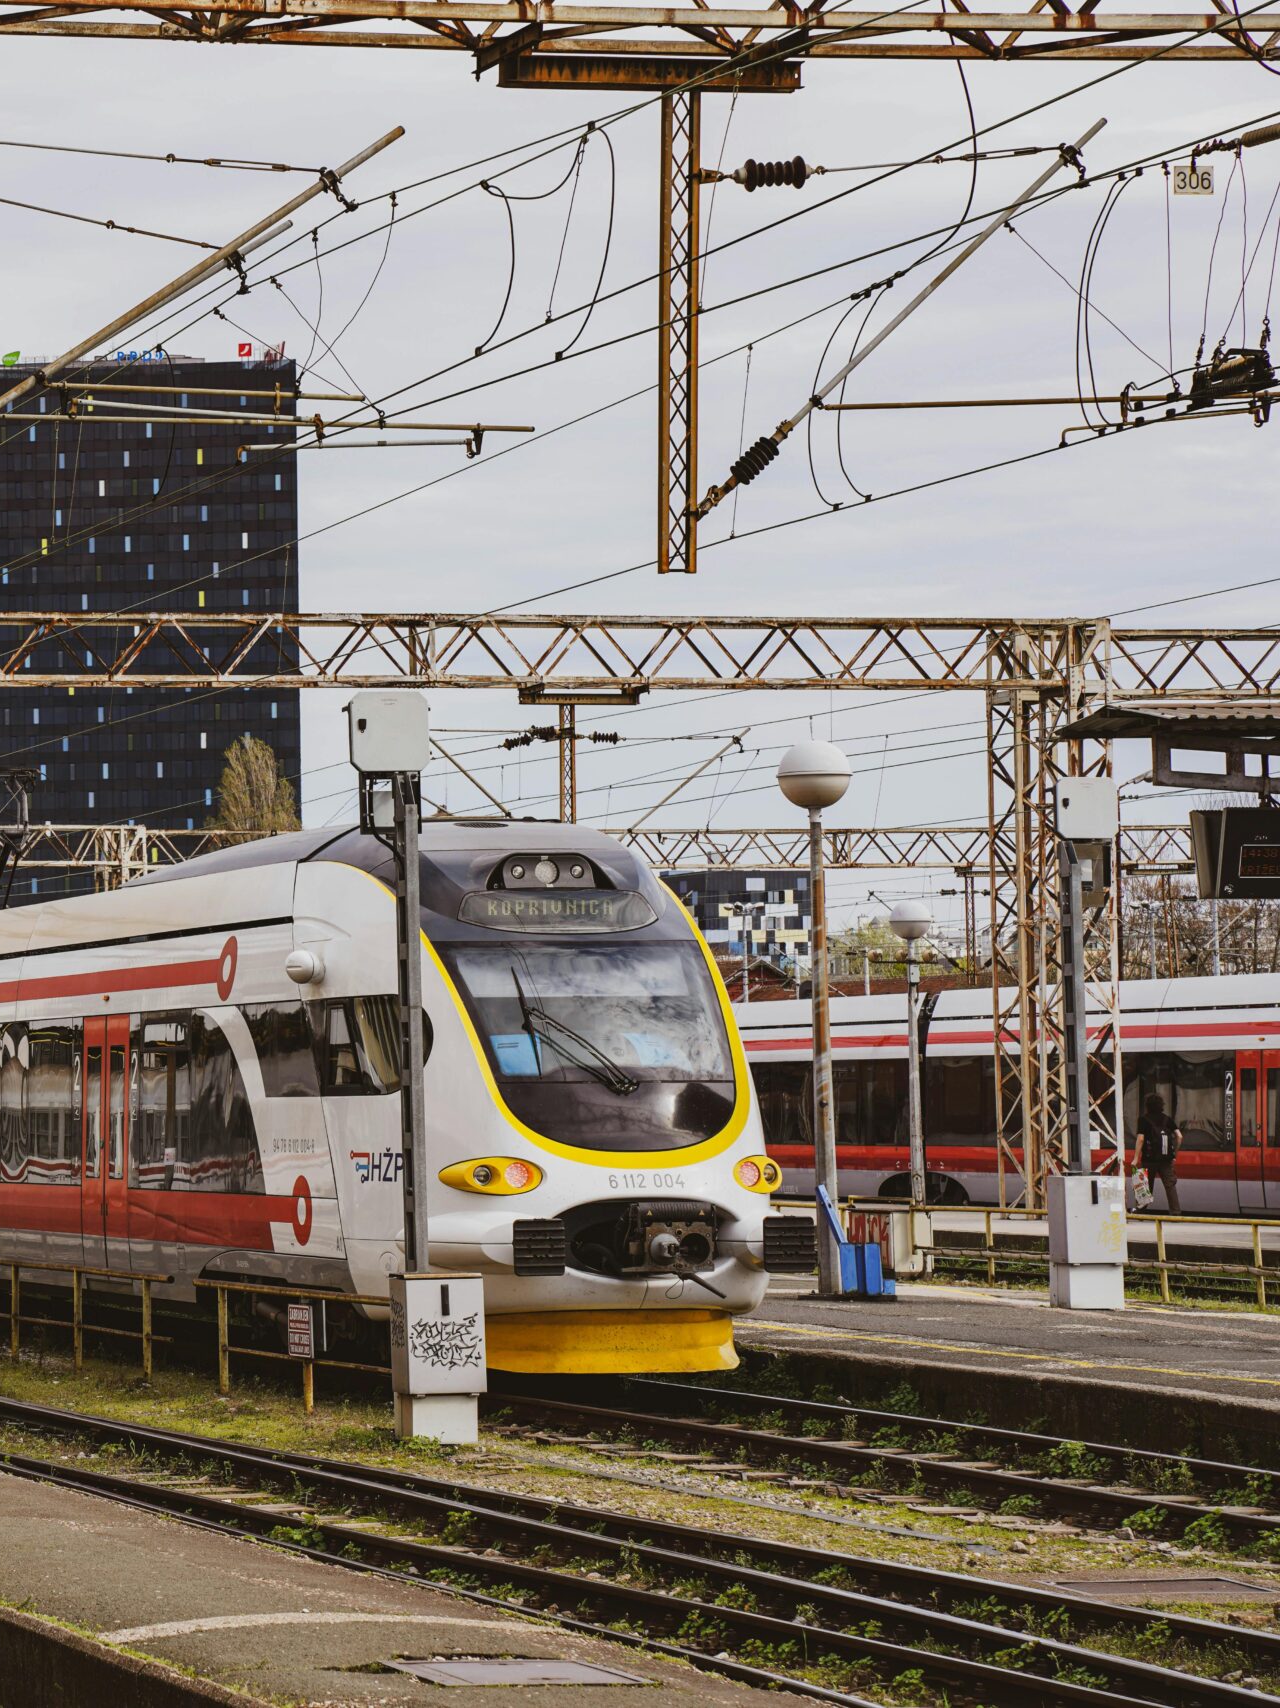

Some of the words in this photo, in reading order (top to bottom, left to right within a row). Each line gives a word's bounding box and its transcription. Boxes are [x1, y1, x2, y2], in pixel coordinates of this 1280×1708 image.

[1176, 171, 1211, 190] 306
[487, 900, 613, 916] KOPRIVNICA
[73, 1055, 80, 1091] 2
[131, 1052, 138, 1090] 2
[1225, 1072, 1233, 1095] 2
[371, 1147, 404, 1182] HŽP
[608, 1174, 618, 1189] 6
[623, 1173, 647, 1188] 112
[653, 1173, 685, 1188] 004
